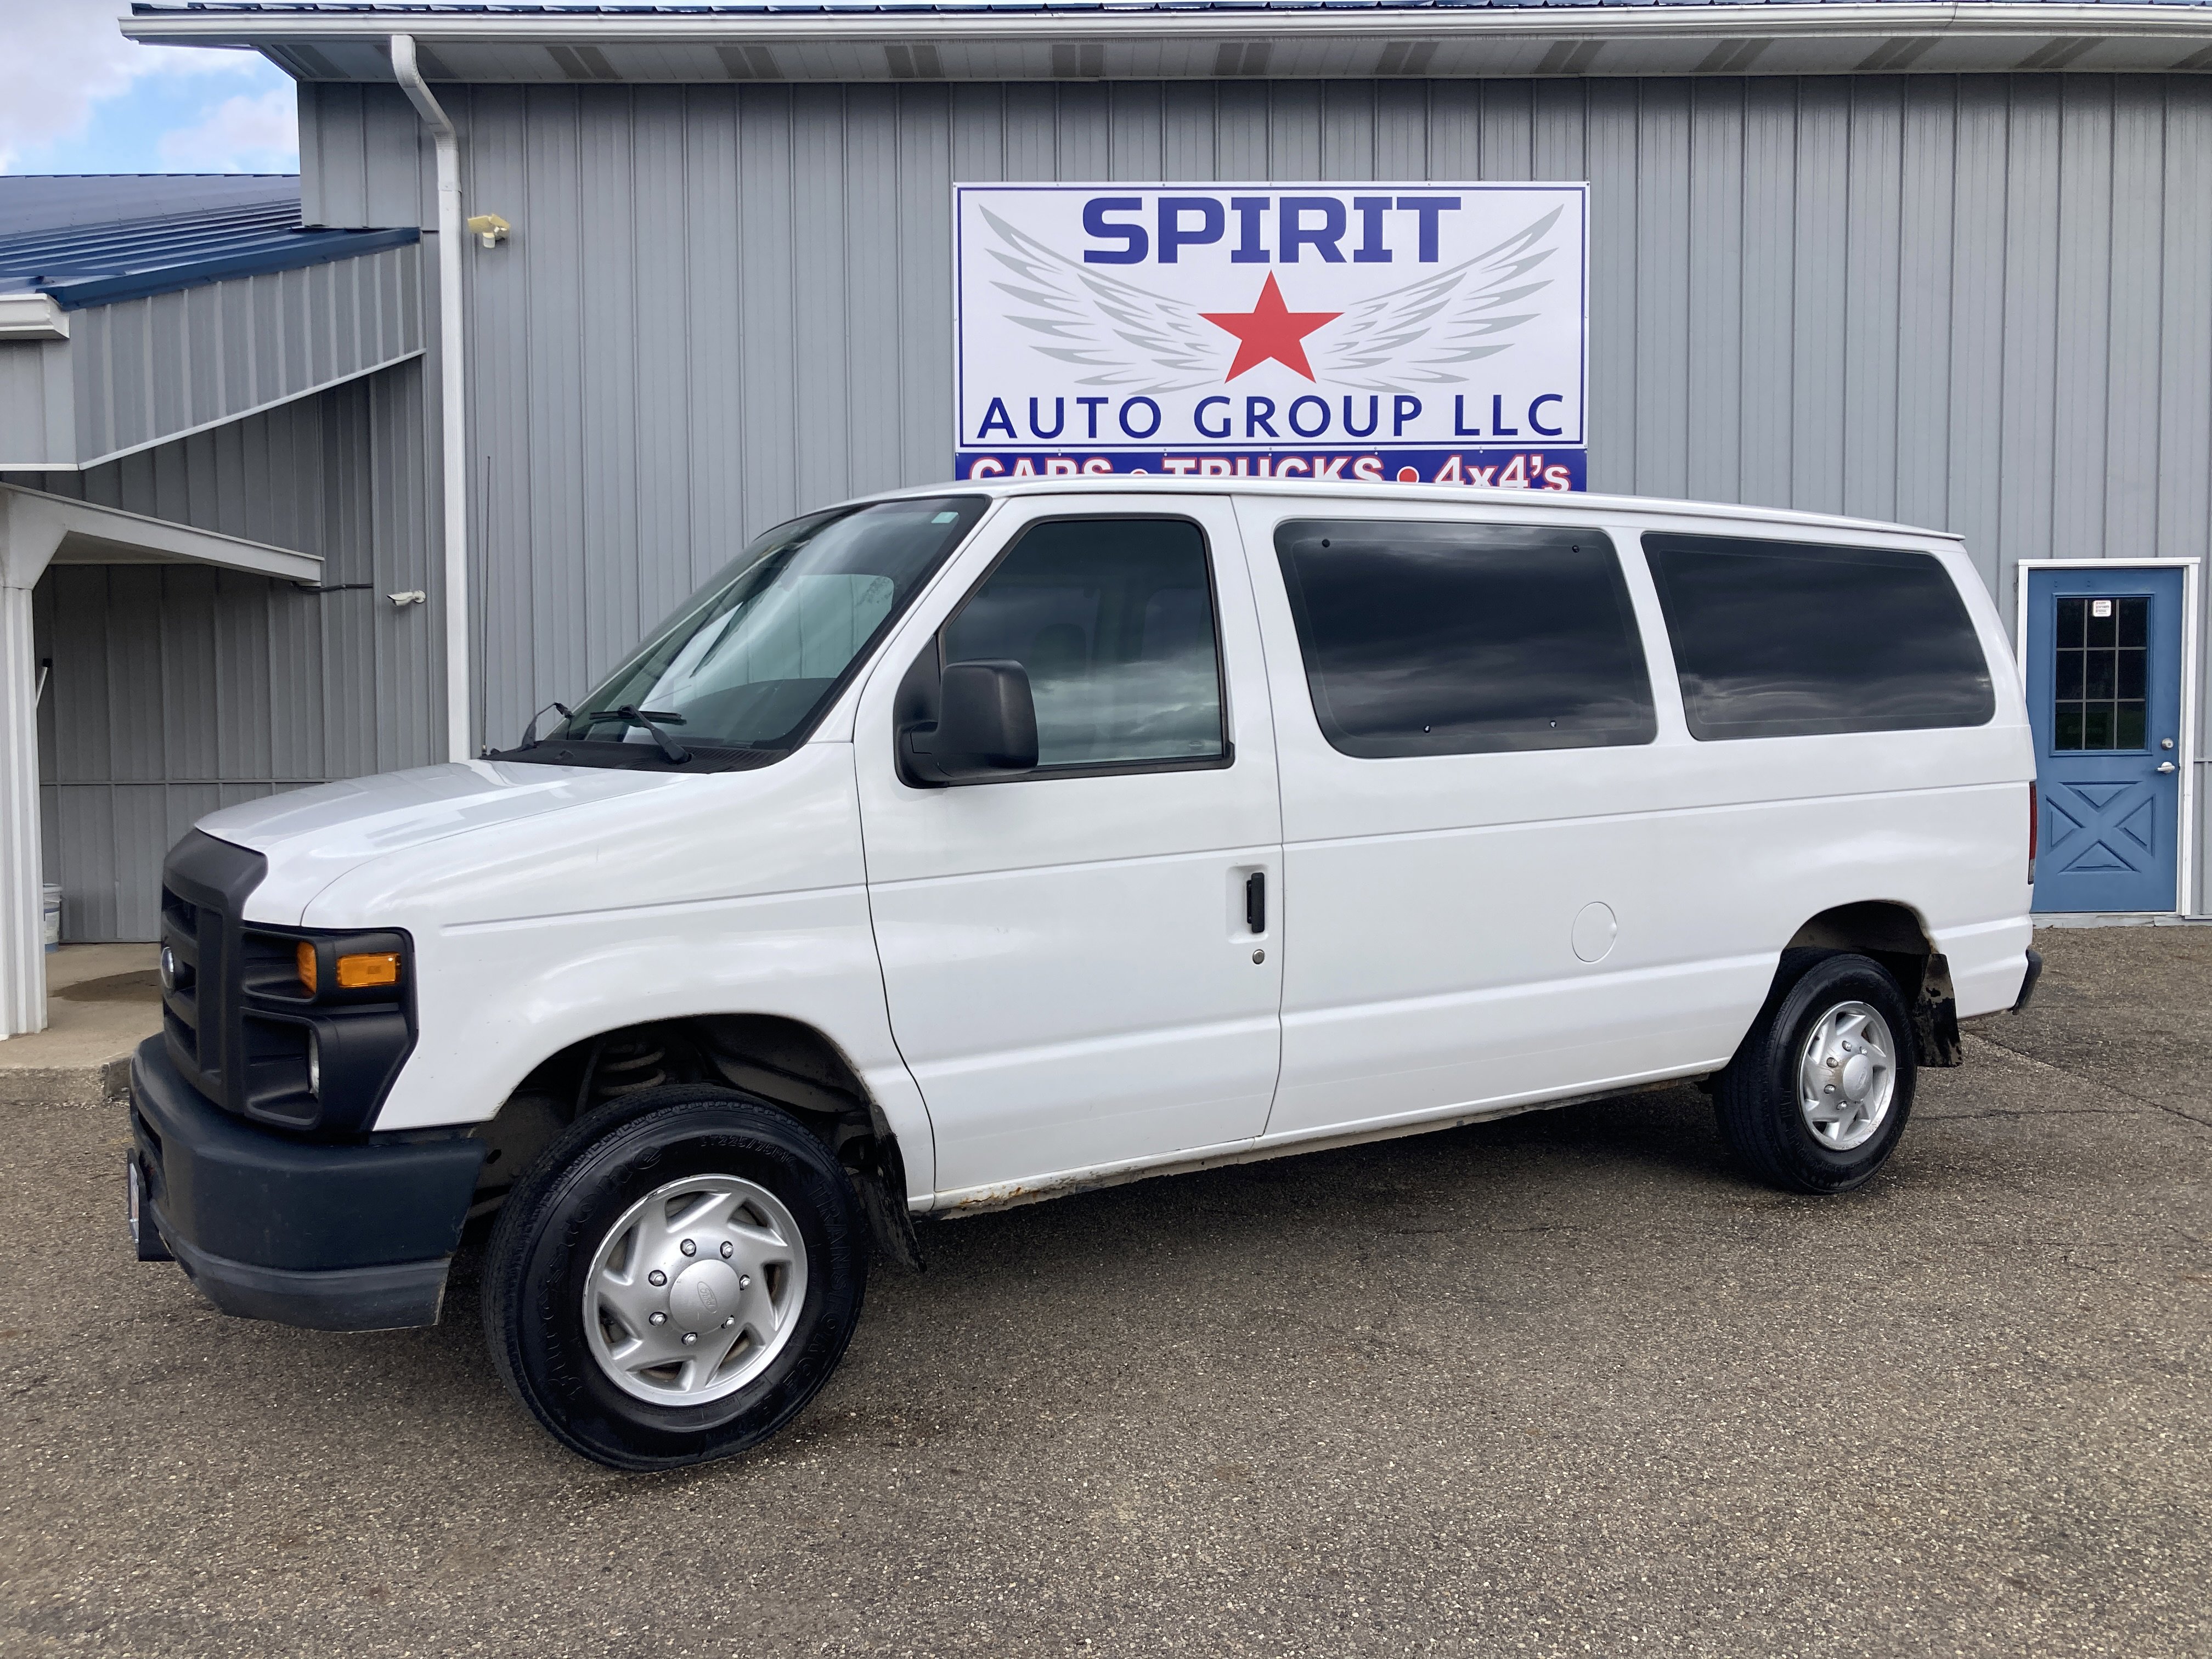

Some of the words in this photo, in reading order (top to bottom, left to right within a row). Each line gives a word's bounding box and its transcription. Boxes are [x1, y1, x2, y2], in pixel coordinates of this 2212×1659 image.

[1082, 197, 1460, 264] SPIRIT
[978, 396, 1161, 439] AUTO
[1194, 395, 1422, 438] GROUP
[1455, 394, 1562, 436] LLC
[1434, 454, 1571, 492] 4x4's
